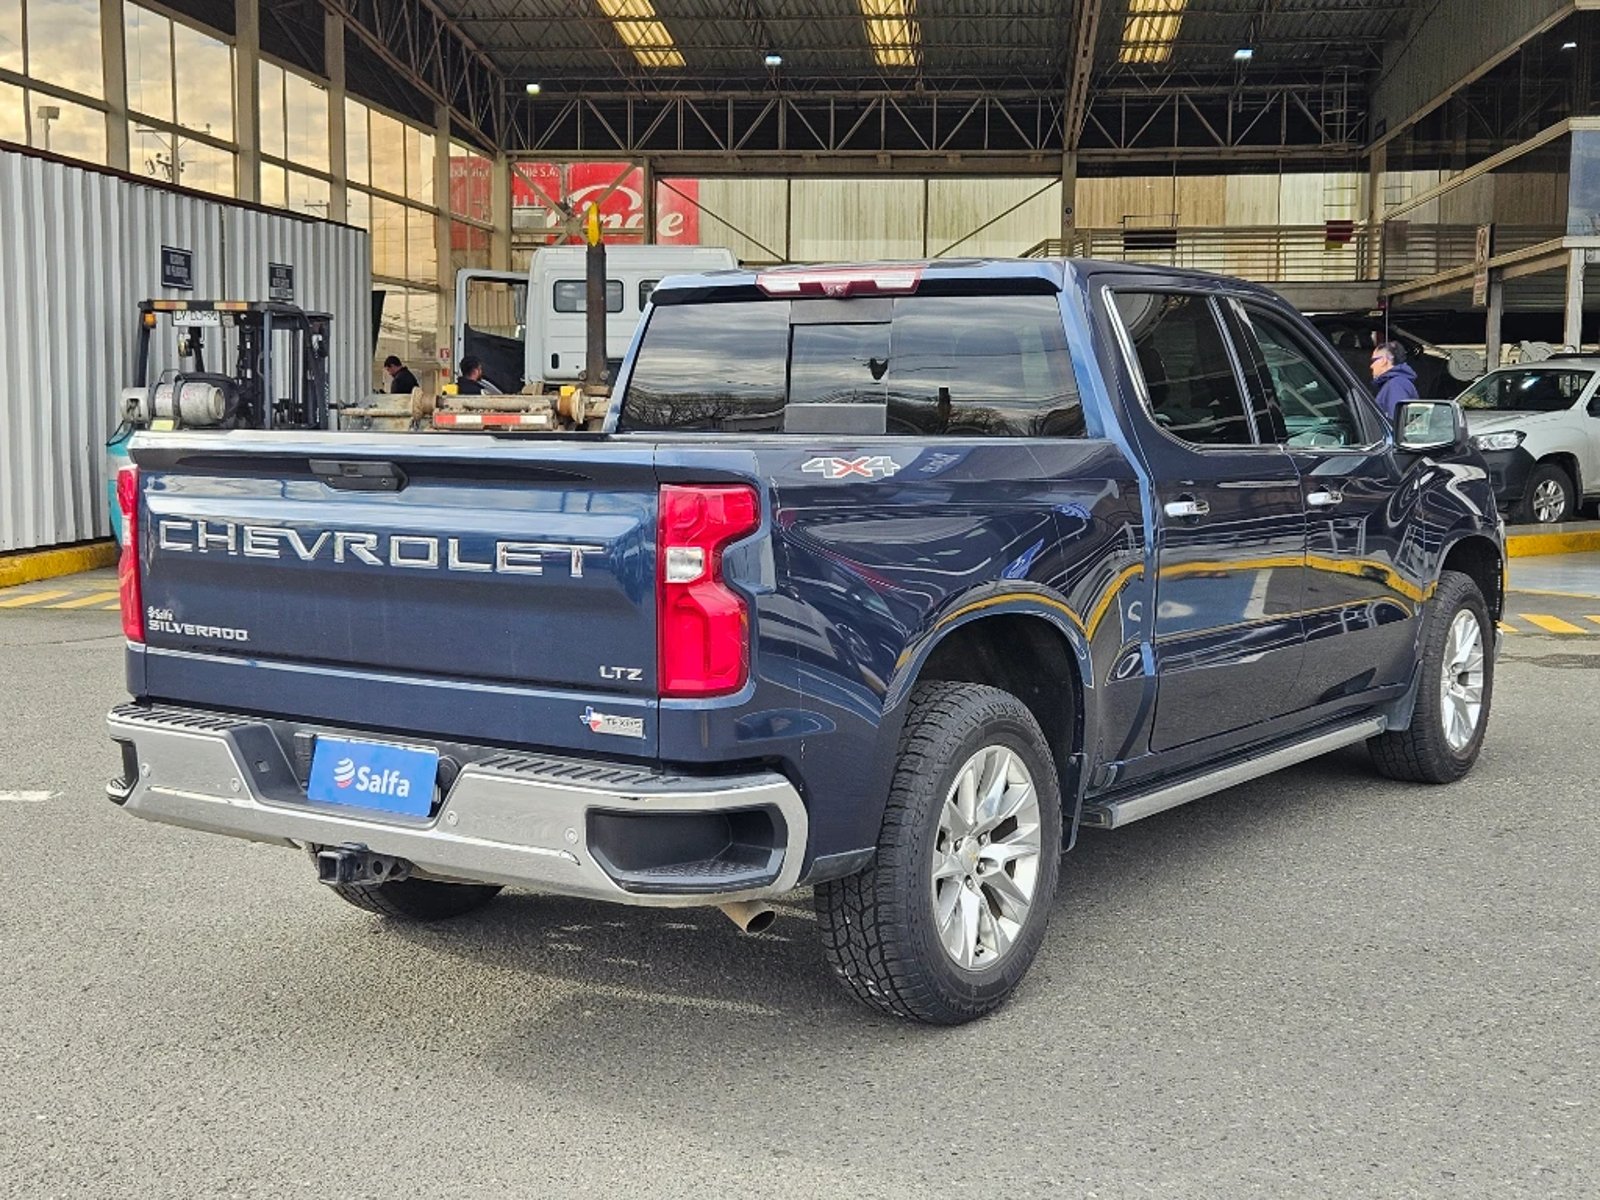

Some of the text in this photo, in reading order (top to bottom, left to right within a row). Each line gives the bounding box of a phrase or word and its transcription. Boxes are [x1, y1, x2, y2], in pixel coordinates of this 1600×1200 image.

[158, 519, 604, 577] CHEVROLET
[148, 619, 248, 641] SILVERADO
[600, 665, 643, 681] LTZ
[355, 766, 411, 798] Salfa
